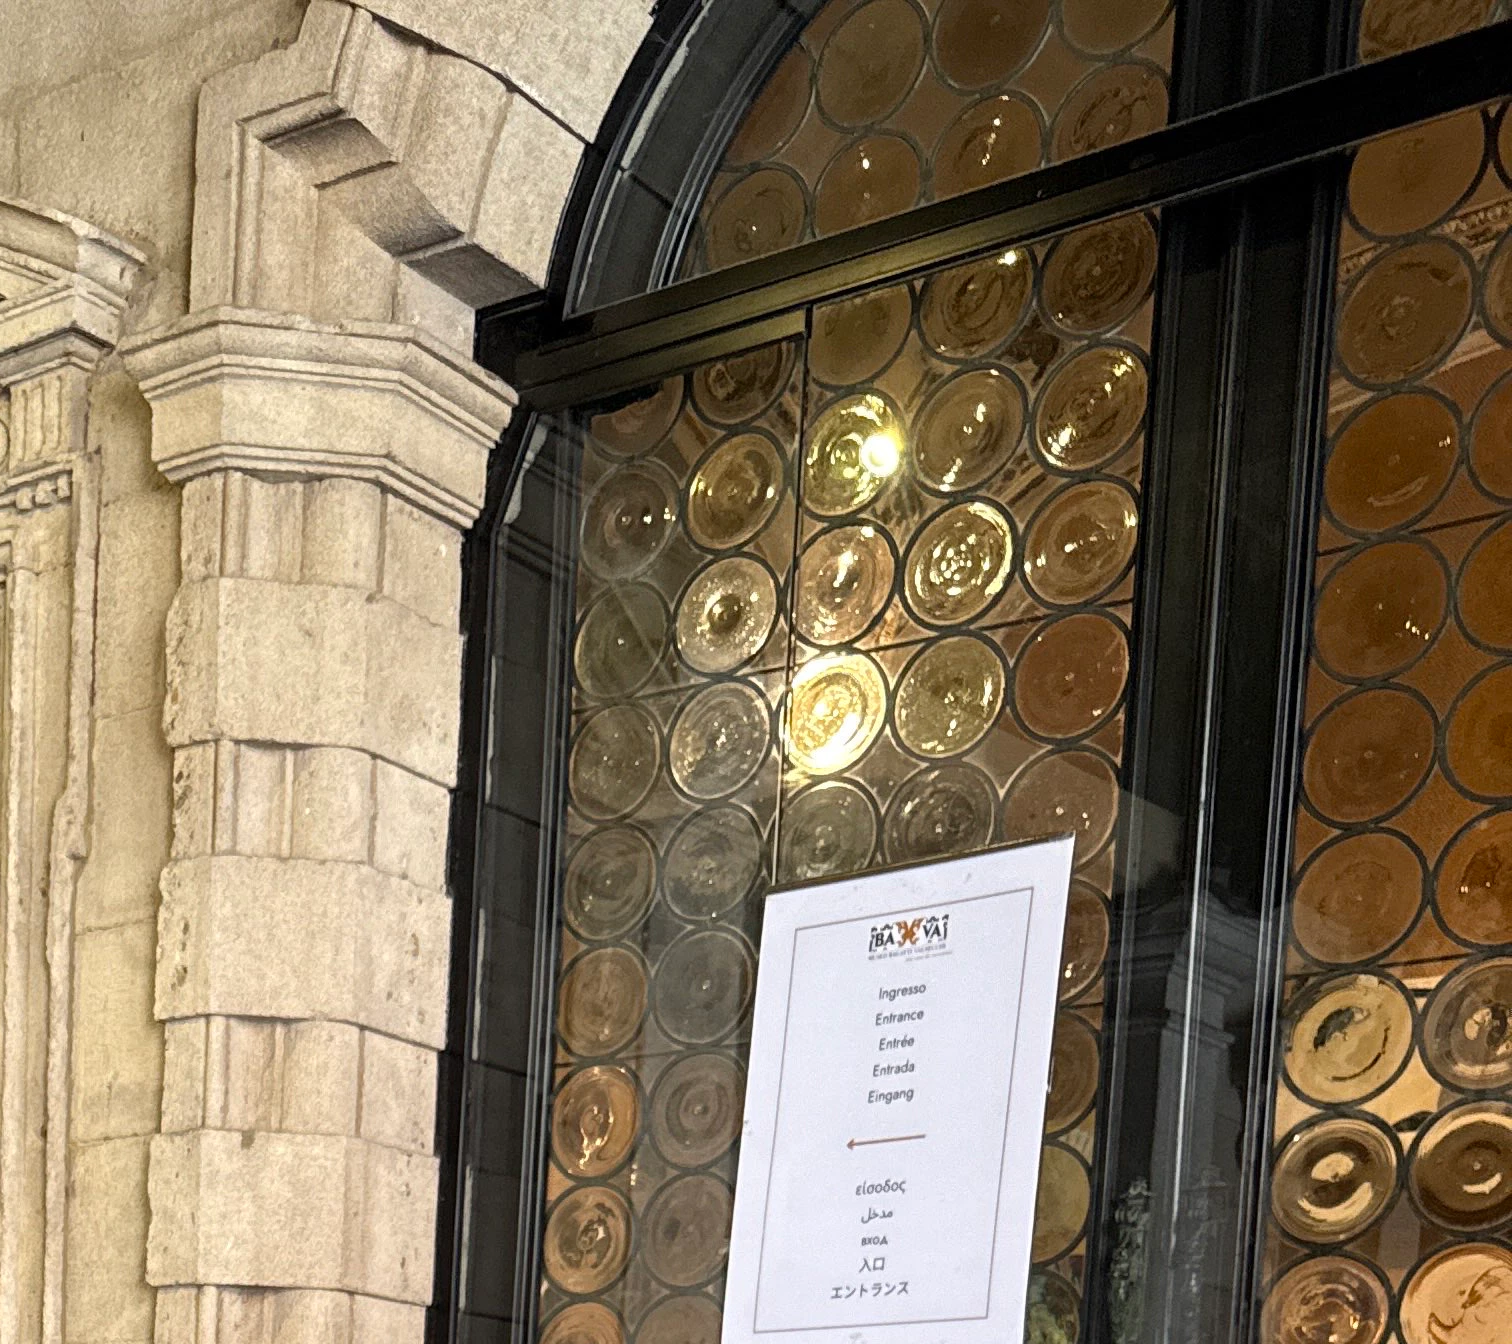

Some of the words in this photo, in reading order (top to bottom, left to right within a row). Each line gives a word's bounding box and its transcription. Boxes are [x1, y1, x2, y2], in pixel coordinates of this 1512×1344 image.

[878, 983, 927, 1001] Ingresso
[875, 1010, 924, 1026] Entrance
[878, 1034, 915, 1051] Entrée
[872, 1058, 915, 1077] Entrada
[867, 1088, 915, 1105] Eingang
[855, 1178, 906, 1196] είσοδος
[860, 1207, 894, 1224] مدخل
[858, 1256, 886, 1273] 入口
[830, 1281, 909, 1300] エントランス
